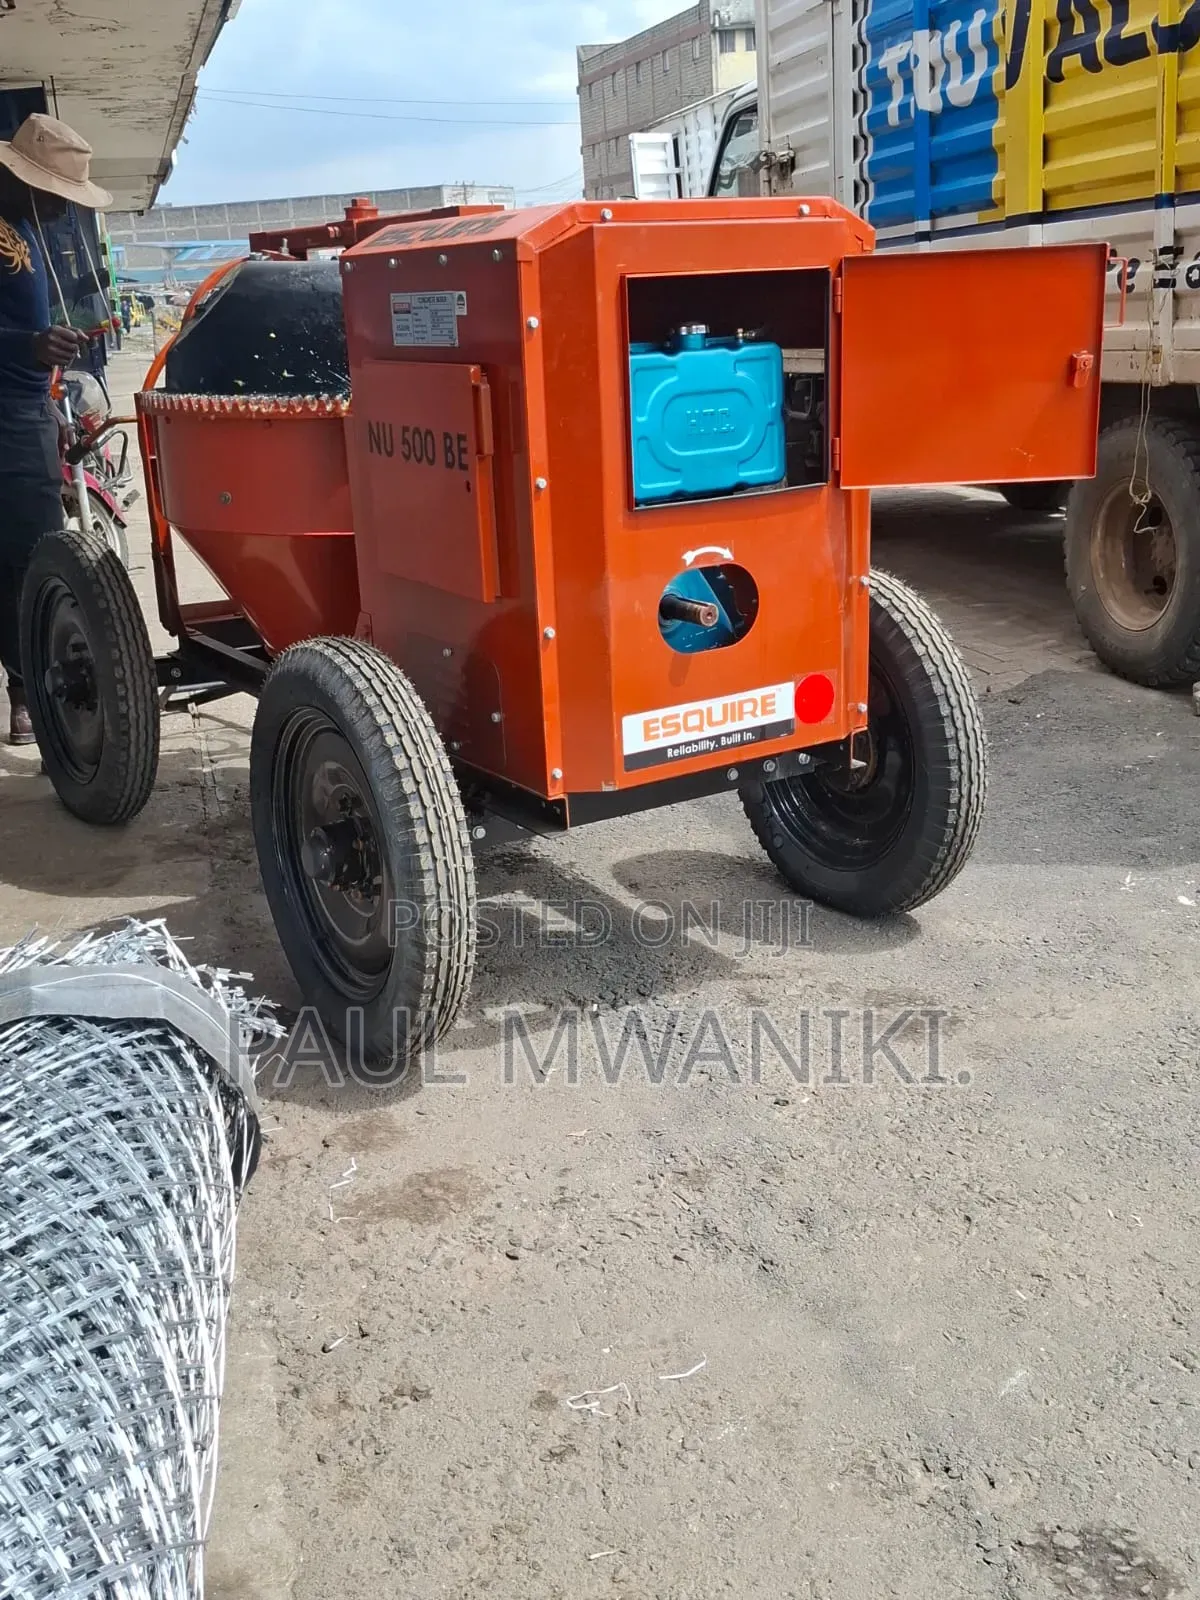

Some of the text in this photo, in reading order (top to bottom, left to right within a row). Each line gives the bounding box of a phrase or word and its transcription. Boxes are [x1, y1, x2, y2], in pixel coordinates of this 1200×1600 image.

[367, 420, 469, 471] NU 500 BE
[642, 693, 776, 742] ESQUIRE
[667, 739, 719, 758] Reliability.
[720, 732, 741, 746] Built
